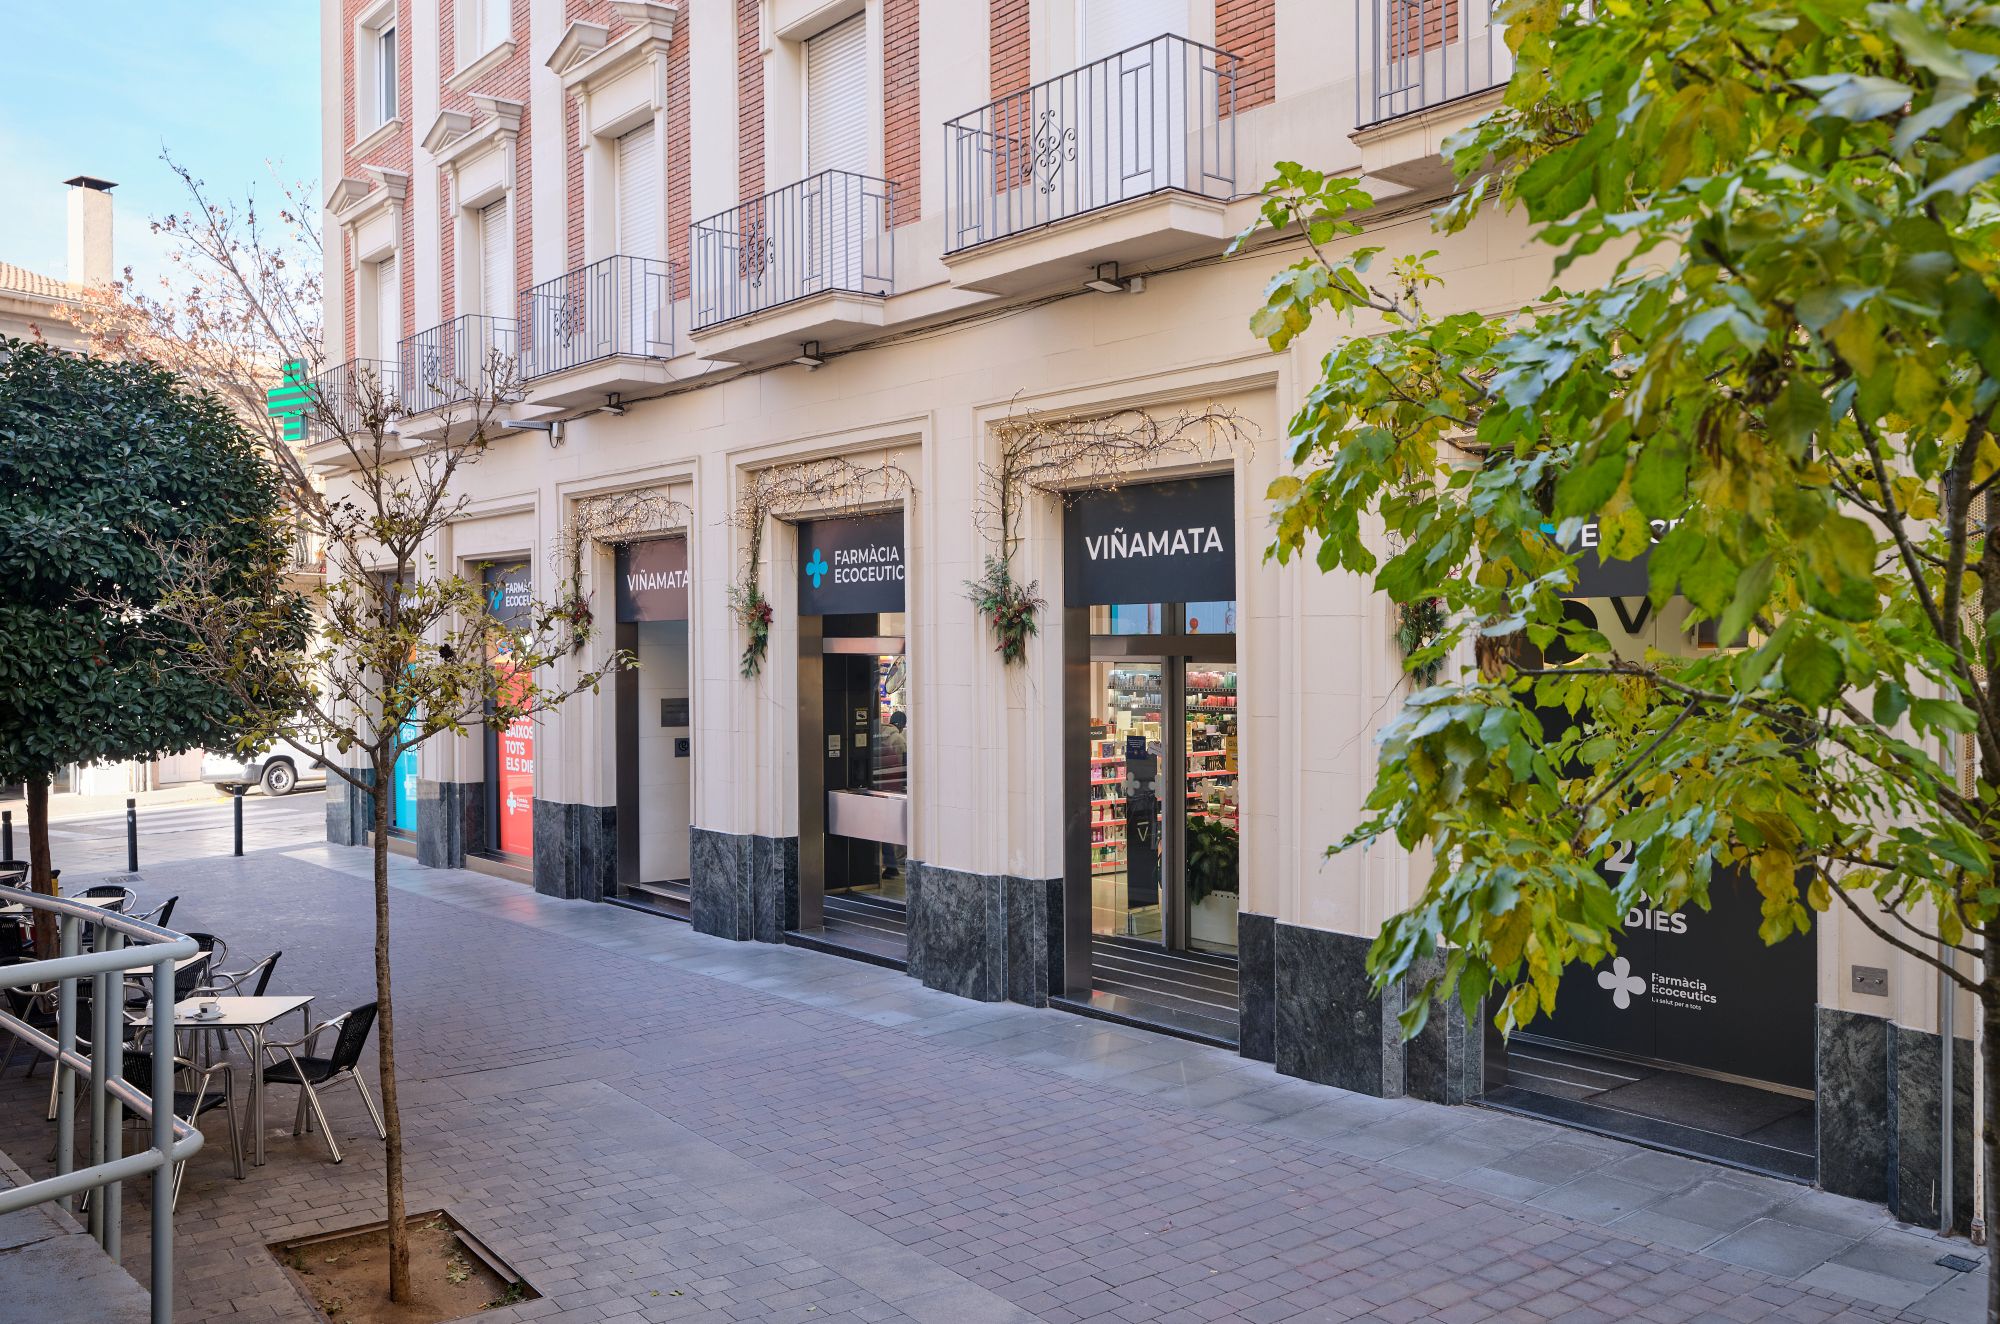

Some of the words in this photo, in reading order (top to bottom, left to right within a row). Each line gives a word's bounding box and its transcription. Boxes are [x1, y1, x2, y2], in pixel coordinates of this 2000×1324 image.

[1085, 526, 1224, 560] VIÑAMATA
[834, 544, 900, 566] FARMÀCIA
[627, 569, 688, 592] VIÑAMATA
[834, 564, 905, 584] ECOCEUTIC
[505, 740, 526, 755] TOTS
[506, 757, 520, 771] ELS
[1624, 907, 1688, 934] DIES
[1651, 972, 1707, 991] Farmàcia
[1651, 983, 1717, 1003] Ecoceutics
